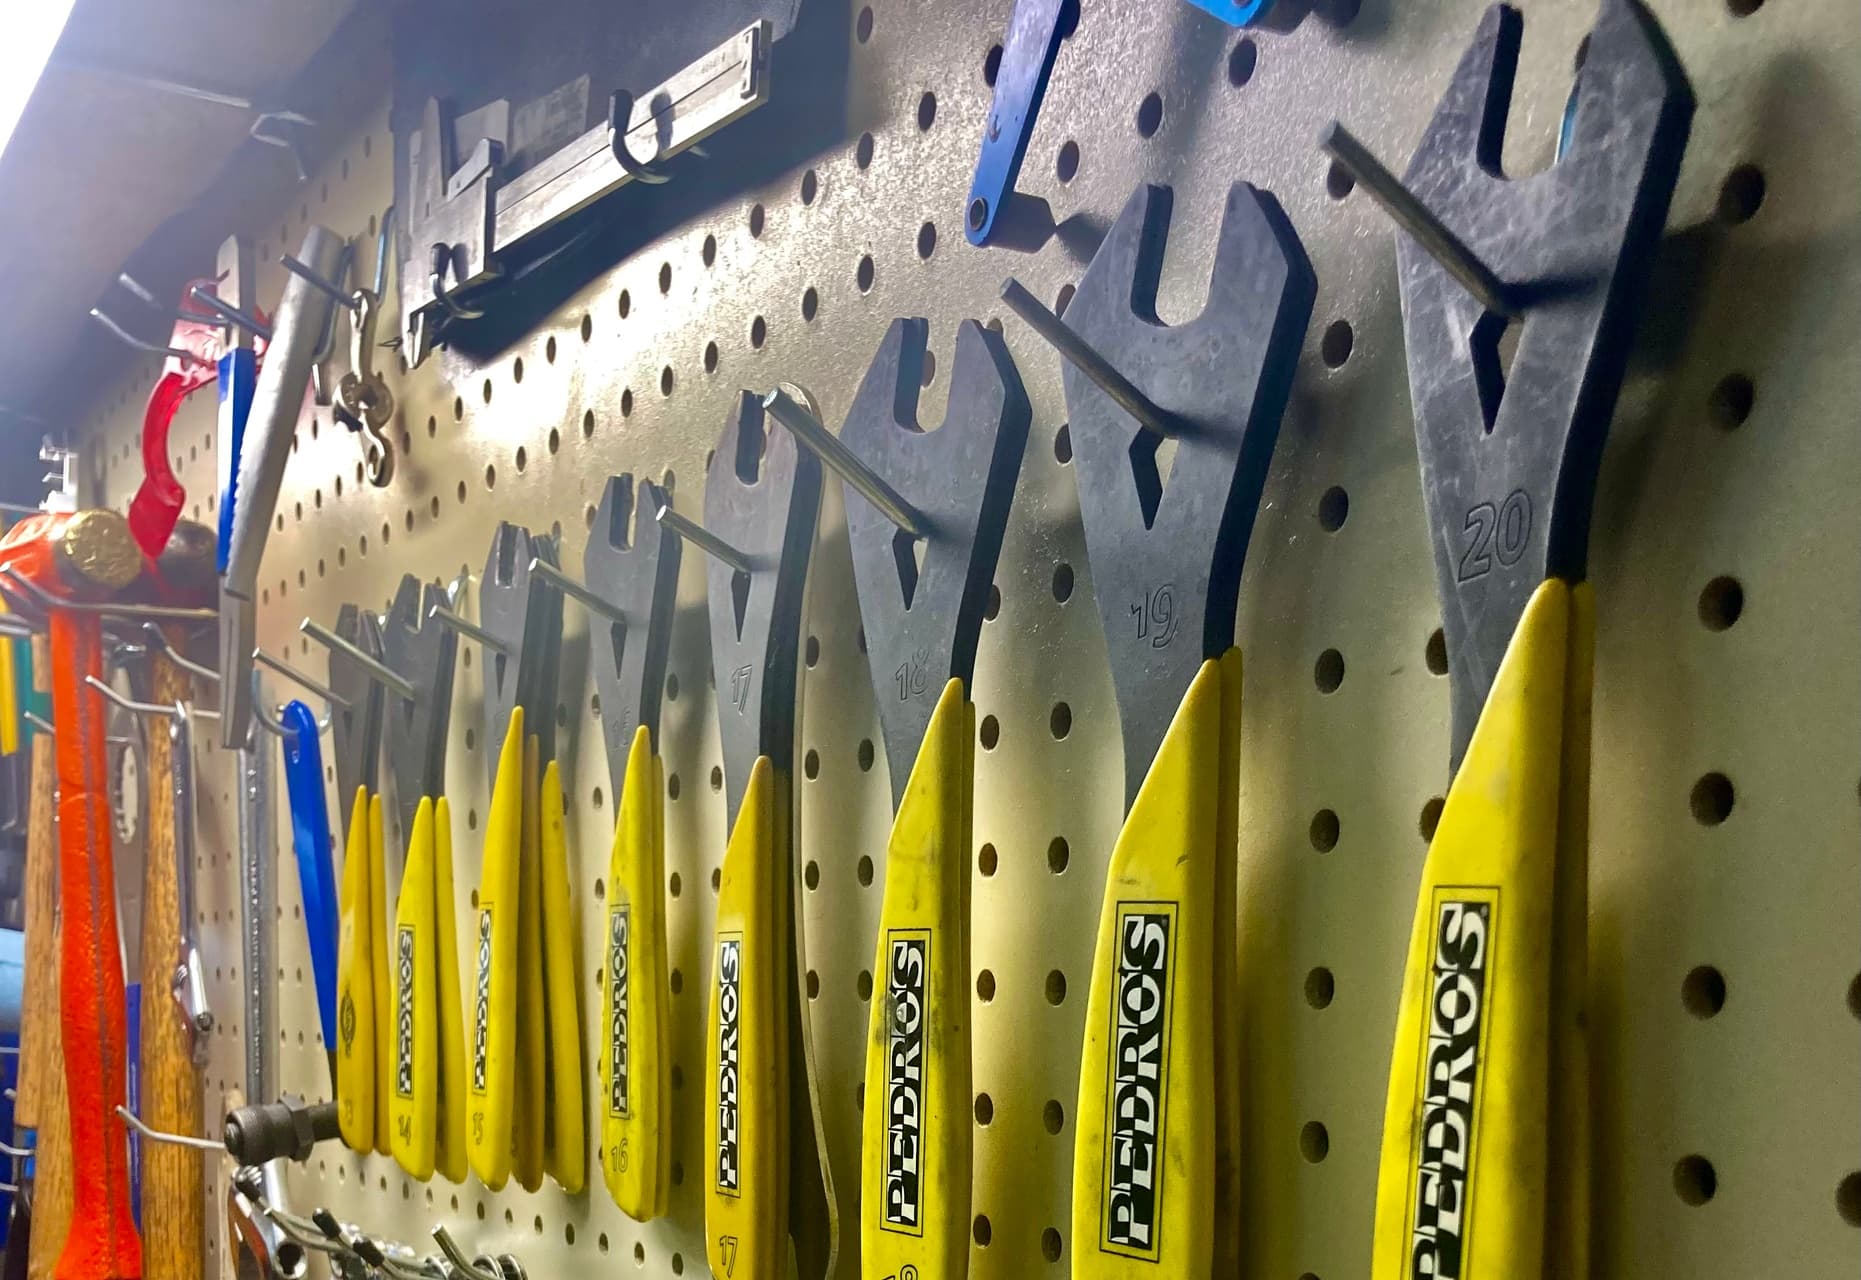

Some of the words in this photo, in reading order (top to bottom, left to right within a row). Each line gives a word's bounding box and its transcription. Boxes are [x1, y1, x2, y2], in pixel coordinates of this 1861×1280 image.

[1458, 489, 1532, 582] 20
[1131, 584, 1178, 648] 19
[731, 664, 752, 715] 17
[896, 649, 929, 701] 18
[398, 1113, 411, 1147] 14
[611, 1138, 629, 1172] 16
[719, 1235, 738, 1279] 17
